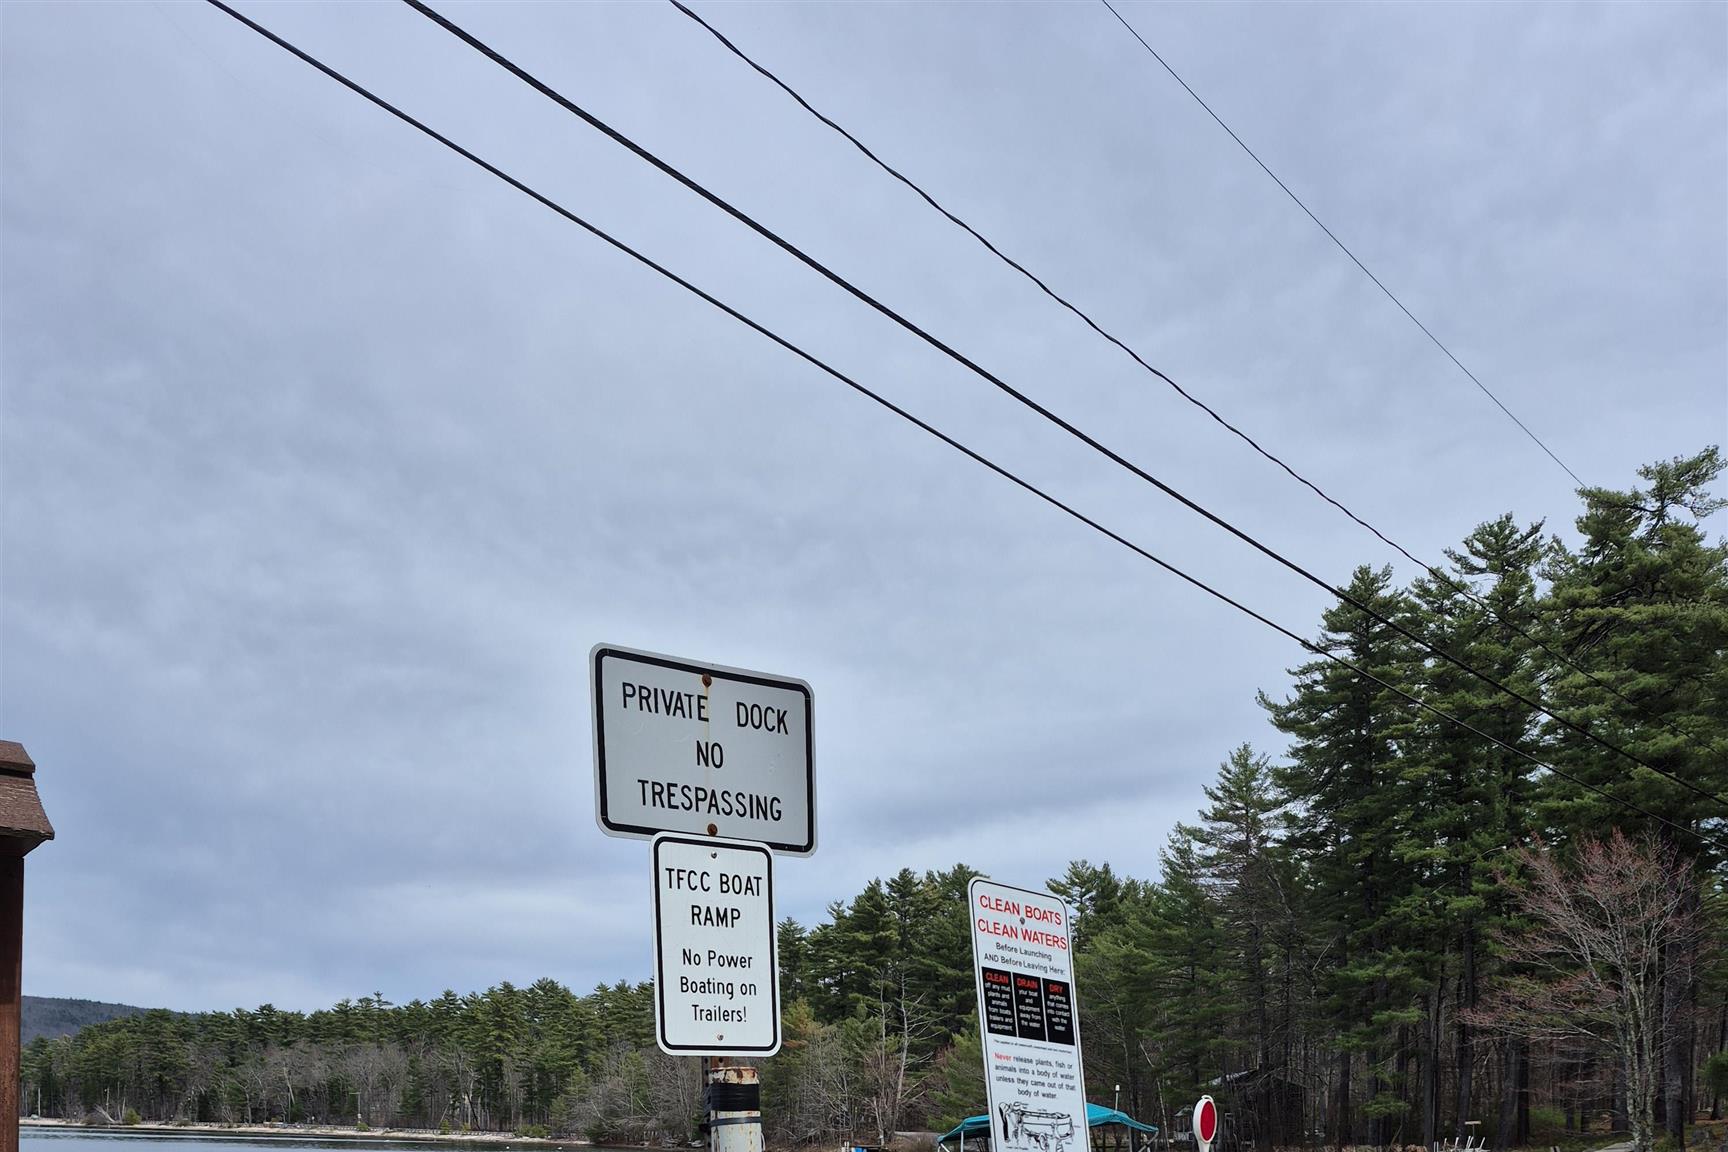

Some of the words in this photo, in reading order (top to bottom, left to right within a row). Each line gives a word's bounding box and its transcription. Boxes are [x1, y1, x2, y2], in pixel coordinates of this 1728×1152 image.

[622, 682, 709, 722] PRIVATE
[736, 702, 788, 735] DOCK
[696, 741, 723, 768] NO
[638, 779, 782, 821] TRESPASSING
[665, 868, 710, 891] TFCC
[720, 873, 762, 896] BOAT
[691, 905, 740, 928] RAMP
[980, 895, 1020, 916] CLEAN
[1025, 905, 1061, 925] BOATS
[978, 919, 1018, 939] CLEAN
[1021, 928, 1067, 950] WATERS
[683, 948, 701, 966] No
[708, 950, 752, 968] Power
[996, 942, 1017, 953] Before
[1020, 948, 1052, 961] Launching
[984, 953, 998, 962] AND
[1001, 957, 1022, 967] Before
[1024, 961, 1048, 973] Leaving
[680, 976, 734, 999] Boating
[740, 983, 756, 995] on
[986, 972, 1008, 984] CLEAN
[1017, 978, 1038, 989] DRAIN
[1049, 984, 1063, 993] DRY
[692, 1005, 747, 1022] Trailers!
[995, 1065, 1016, 1073] animals
[1037, 1069, 1050, 1078] body
[1013, 1056, 1033, 1064] release
[1055, 1060, 1065, 1068] fish
[996, 1075, 1014, 1083] unless
[1017, 1077, 1028, 1086] they
[1017, 1088, 1031, 1097] body
